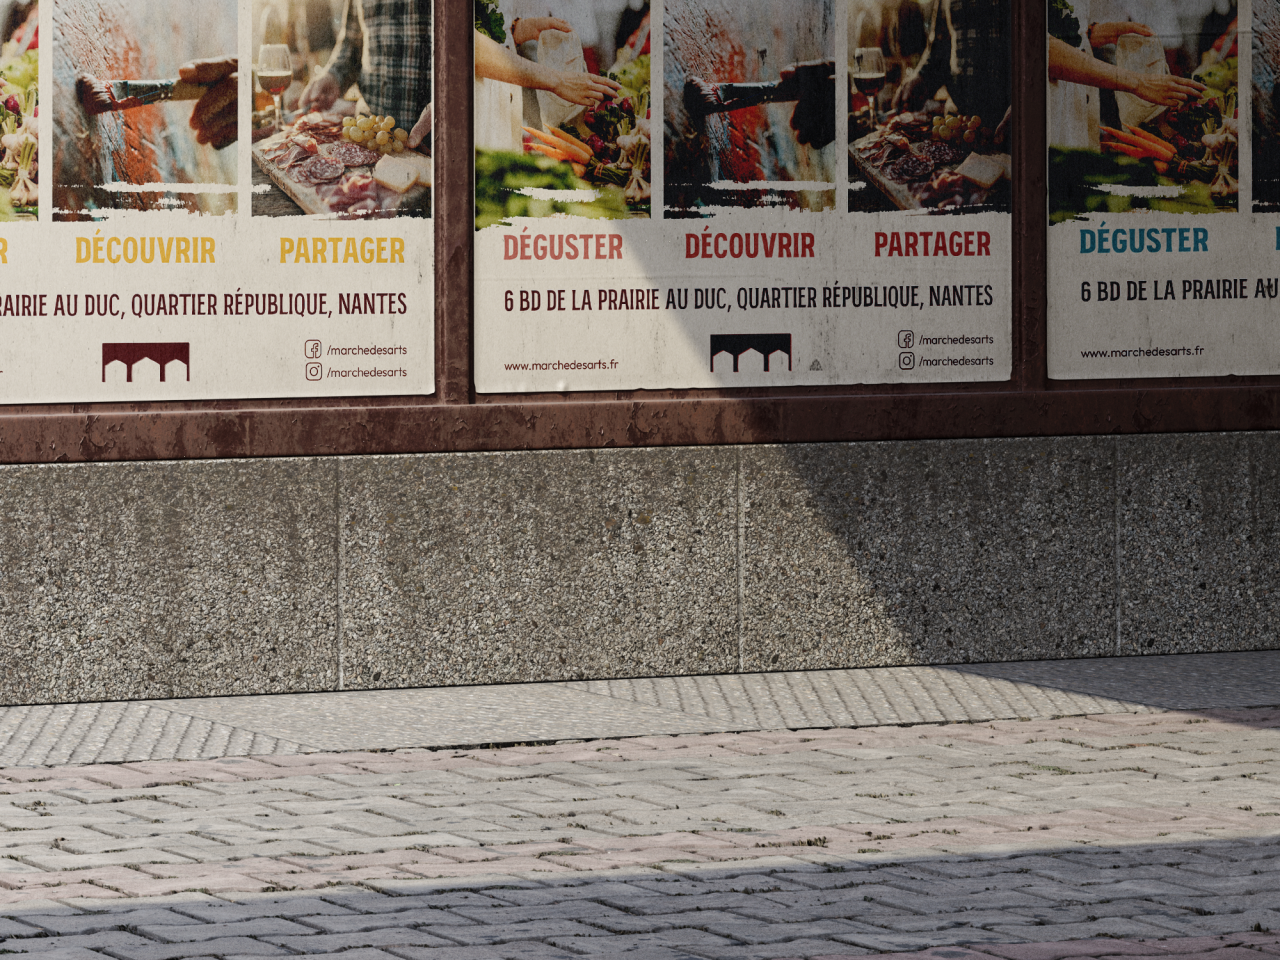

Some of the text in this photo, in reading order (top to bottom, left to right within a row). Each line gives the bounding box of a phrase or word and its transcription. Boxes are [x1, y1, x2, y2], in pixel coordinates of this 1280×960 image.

[75, 229, 215, 264] DÉCOUVRIR
[280, 237, 404, 263] PARTAGER
[504, 227, 623, 261] DÉGUSTER
[685, 226, 815, 259] DÉCOUVRIR
[875, 231, 990, 257] PARTAGER
[1080, 221, 1208, 253] DÉGUSTER
[504, 281, 993, 312] 6 BD DE LA PRAIRIE AU DUC, QUARTIER RÉPUBLIQUE, NANTES
[1081, 278, 1278, 302] 6 BD DE LA PRAIRIE AU
[54, 294, 79, 315] AU
[85, 293, 125, 320] DUC,
[131, 293, 217, 317] QUARTIER
[223, 287, 332, 318] RÉPUBLIQUE,
[338, 293, 407, 315] NANTES
[327, 344, 407, 357] /marchedesarts
[919, 334, 994, 346] /marchedesarts
[1081, 346, 1204, 357] www.marchedesarts.fr
[327, 366, 407, 379] /marchedesarts
[504, 359, 619, 371] www.marchedesarts.fr
[919, 355, 994, 367] /marchedesarts
